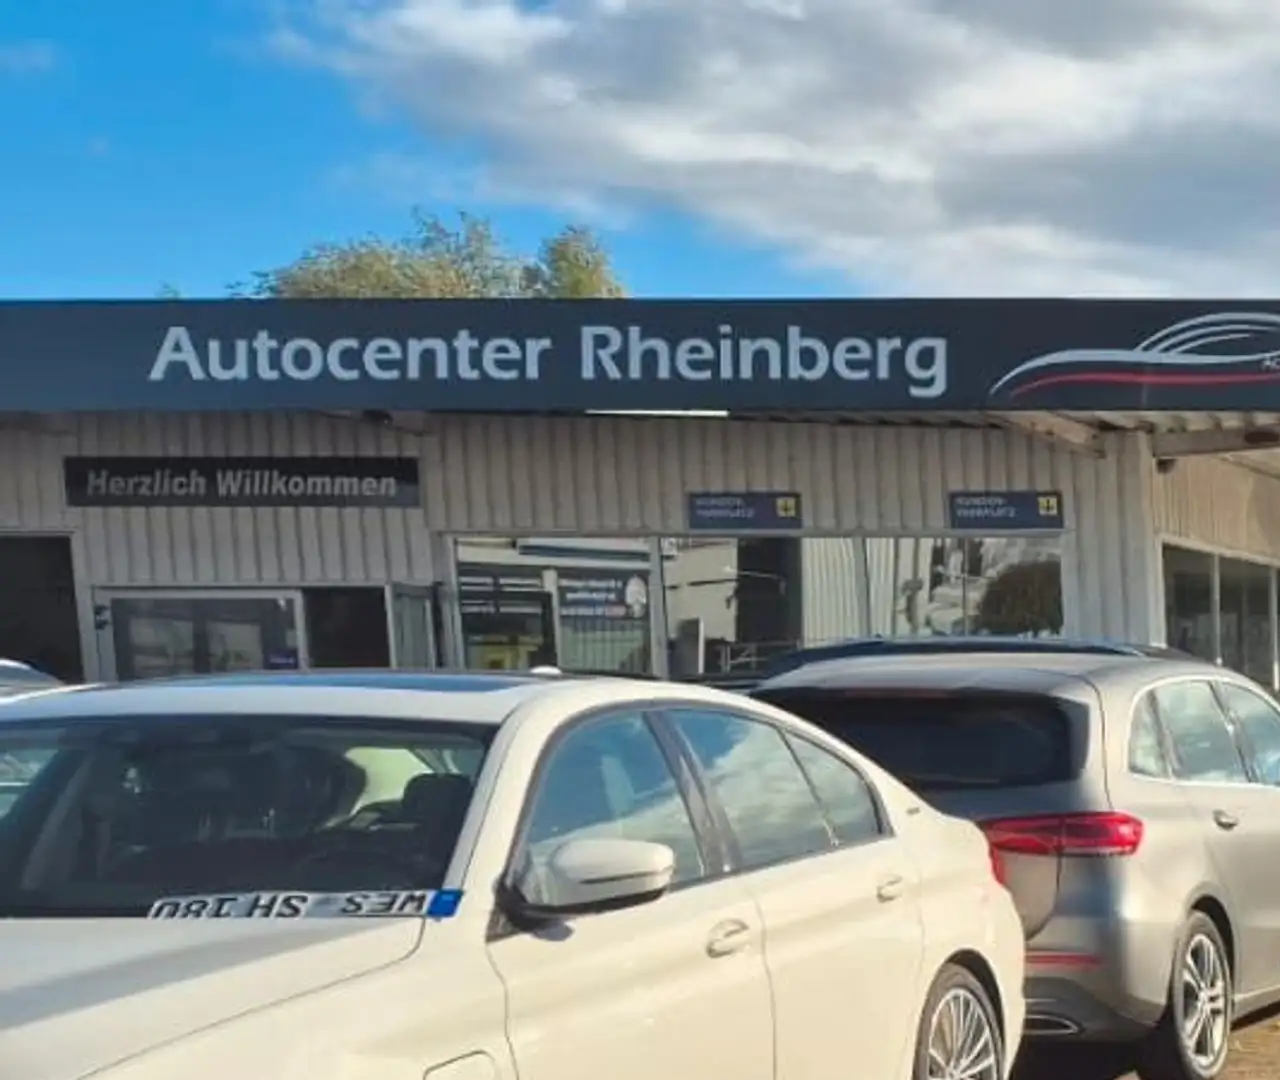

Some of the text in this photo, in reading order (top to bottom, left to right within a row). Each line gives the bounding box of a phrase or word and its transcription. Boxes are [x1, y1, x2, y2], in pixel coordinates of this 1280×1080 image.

[149, 325, 948, 398] Autocenter Rheinberg
[87, 469, 396, 498] Herzlich Willkommen
[250, 894, 309, 919] SH
[341, 892, 426, 915] WES
